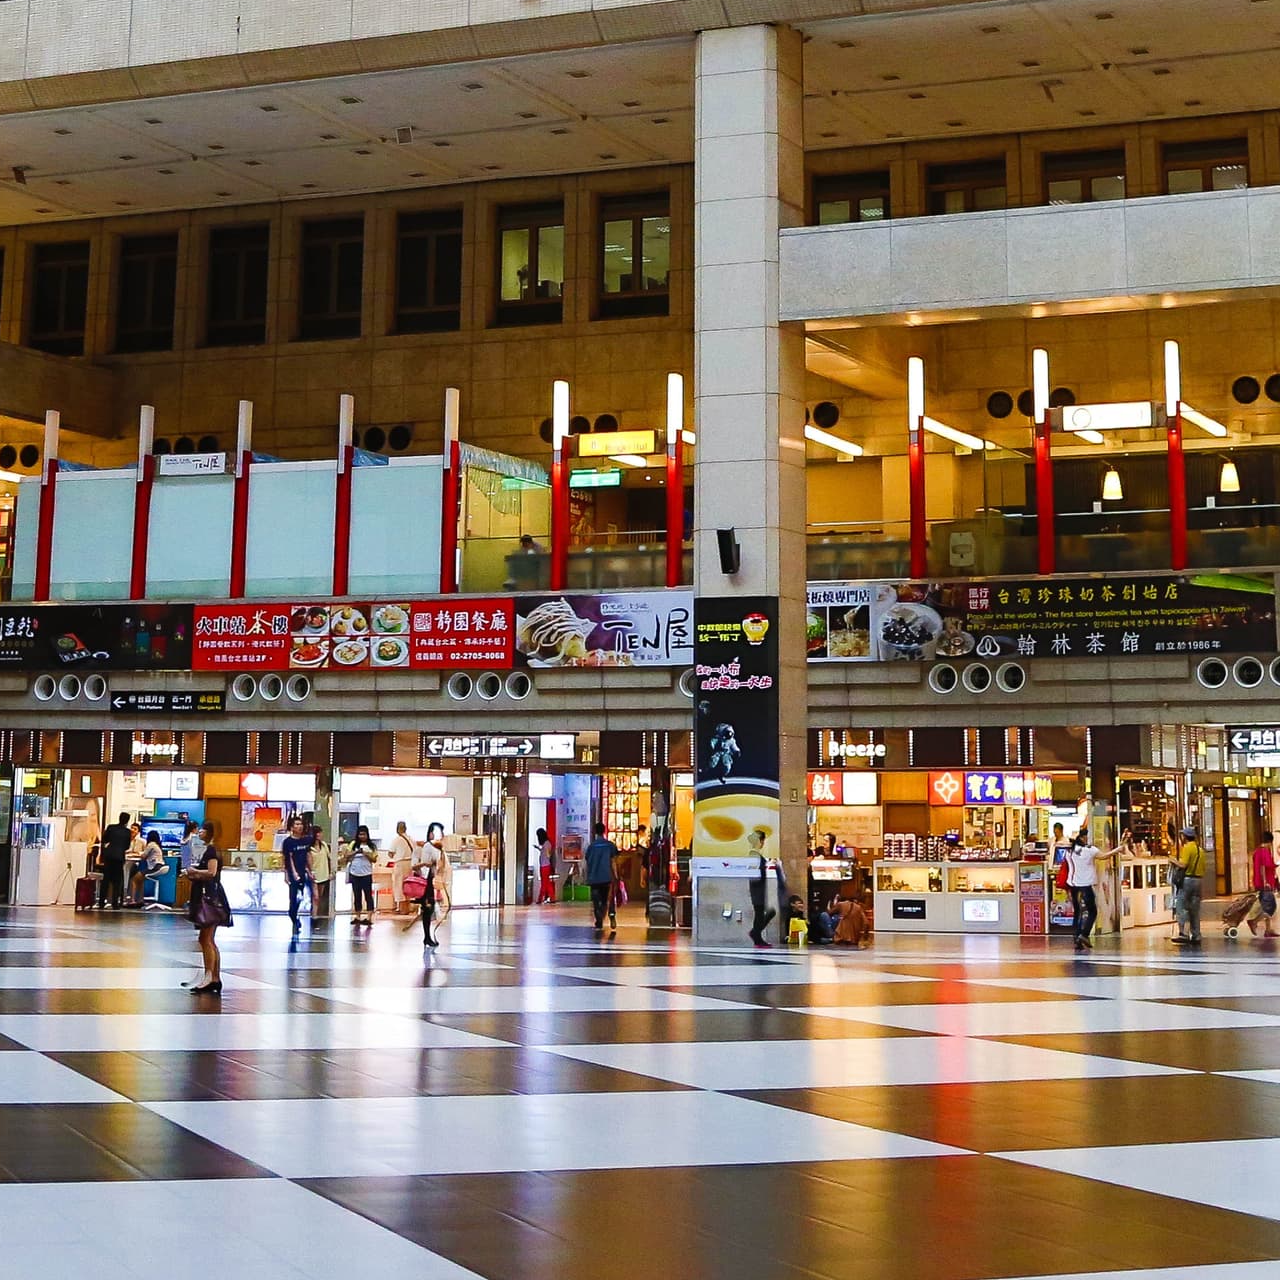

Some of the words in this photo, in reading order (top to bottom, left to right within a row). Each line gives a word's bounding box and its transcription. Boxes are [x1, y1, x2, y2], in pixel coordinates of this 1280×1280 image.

[998, 583, 1180, 604] 台灣珍珠奶茶創始店
[195, 609, 289, 636] 火車站茶樓
[1017, 631, 1140, 656] 翰林茶館
[132, 740, 179, 755] Breeze
[828, 741, 887, 757] Breeze
